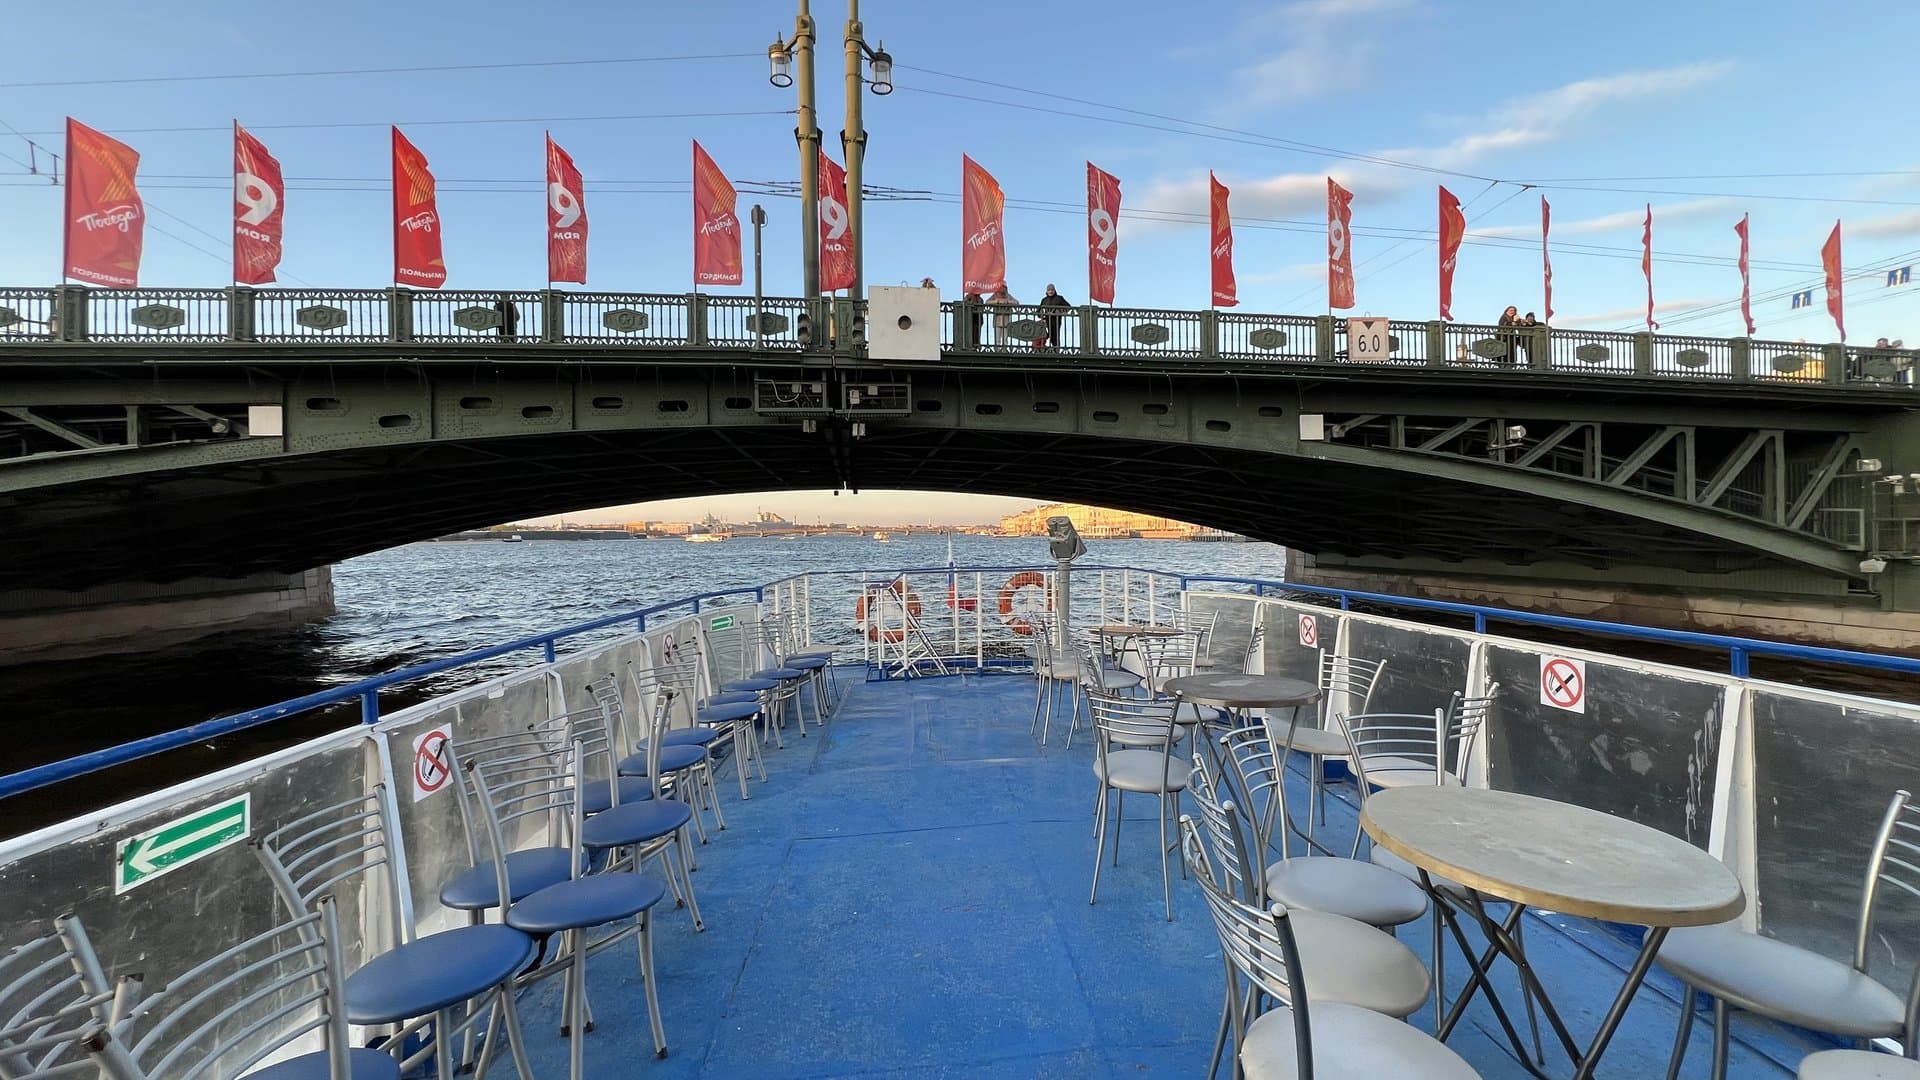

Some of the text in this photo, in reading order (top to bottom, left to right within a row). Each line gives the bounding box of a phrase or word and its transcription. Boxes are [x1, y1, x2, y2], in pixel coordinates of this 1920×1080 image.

[236, 172, 277, 225] 9
[550, 182, 581, 228] 9
[821, 196, 848, 239] 9
[236, 226, 270, 243] мая
[553, 232, 581, 240] мая
[1091, 209, 1115, 252] 9
[1330, 219, 1344, 261] 9
[1358, 334, 1380, 353] 6.0
